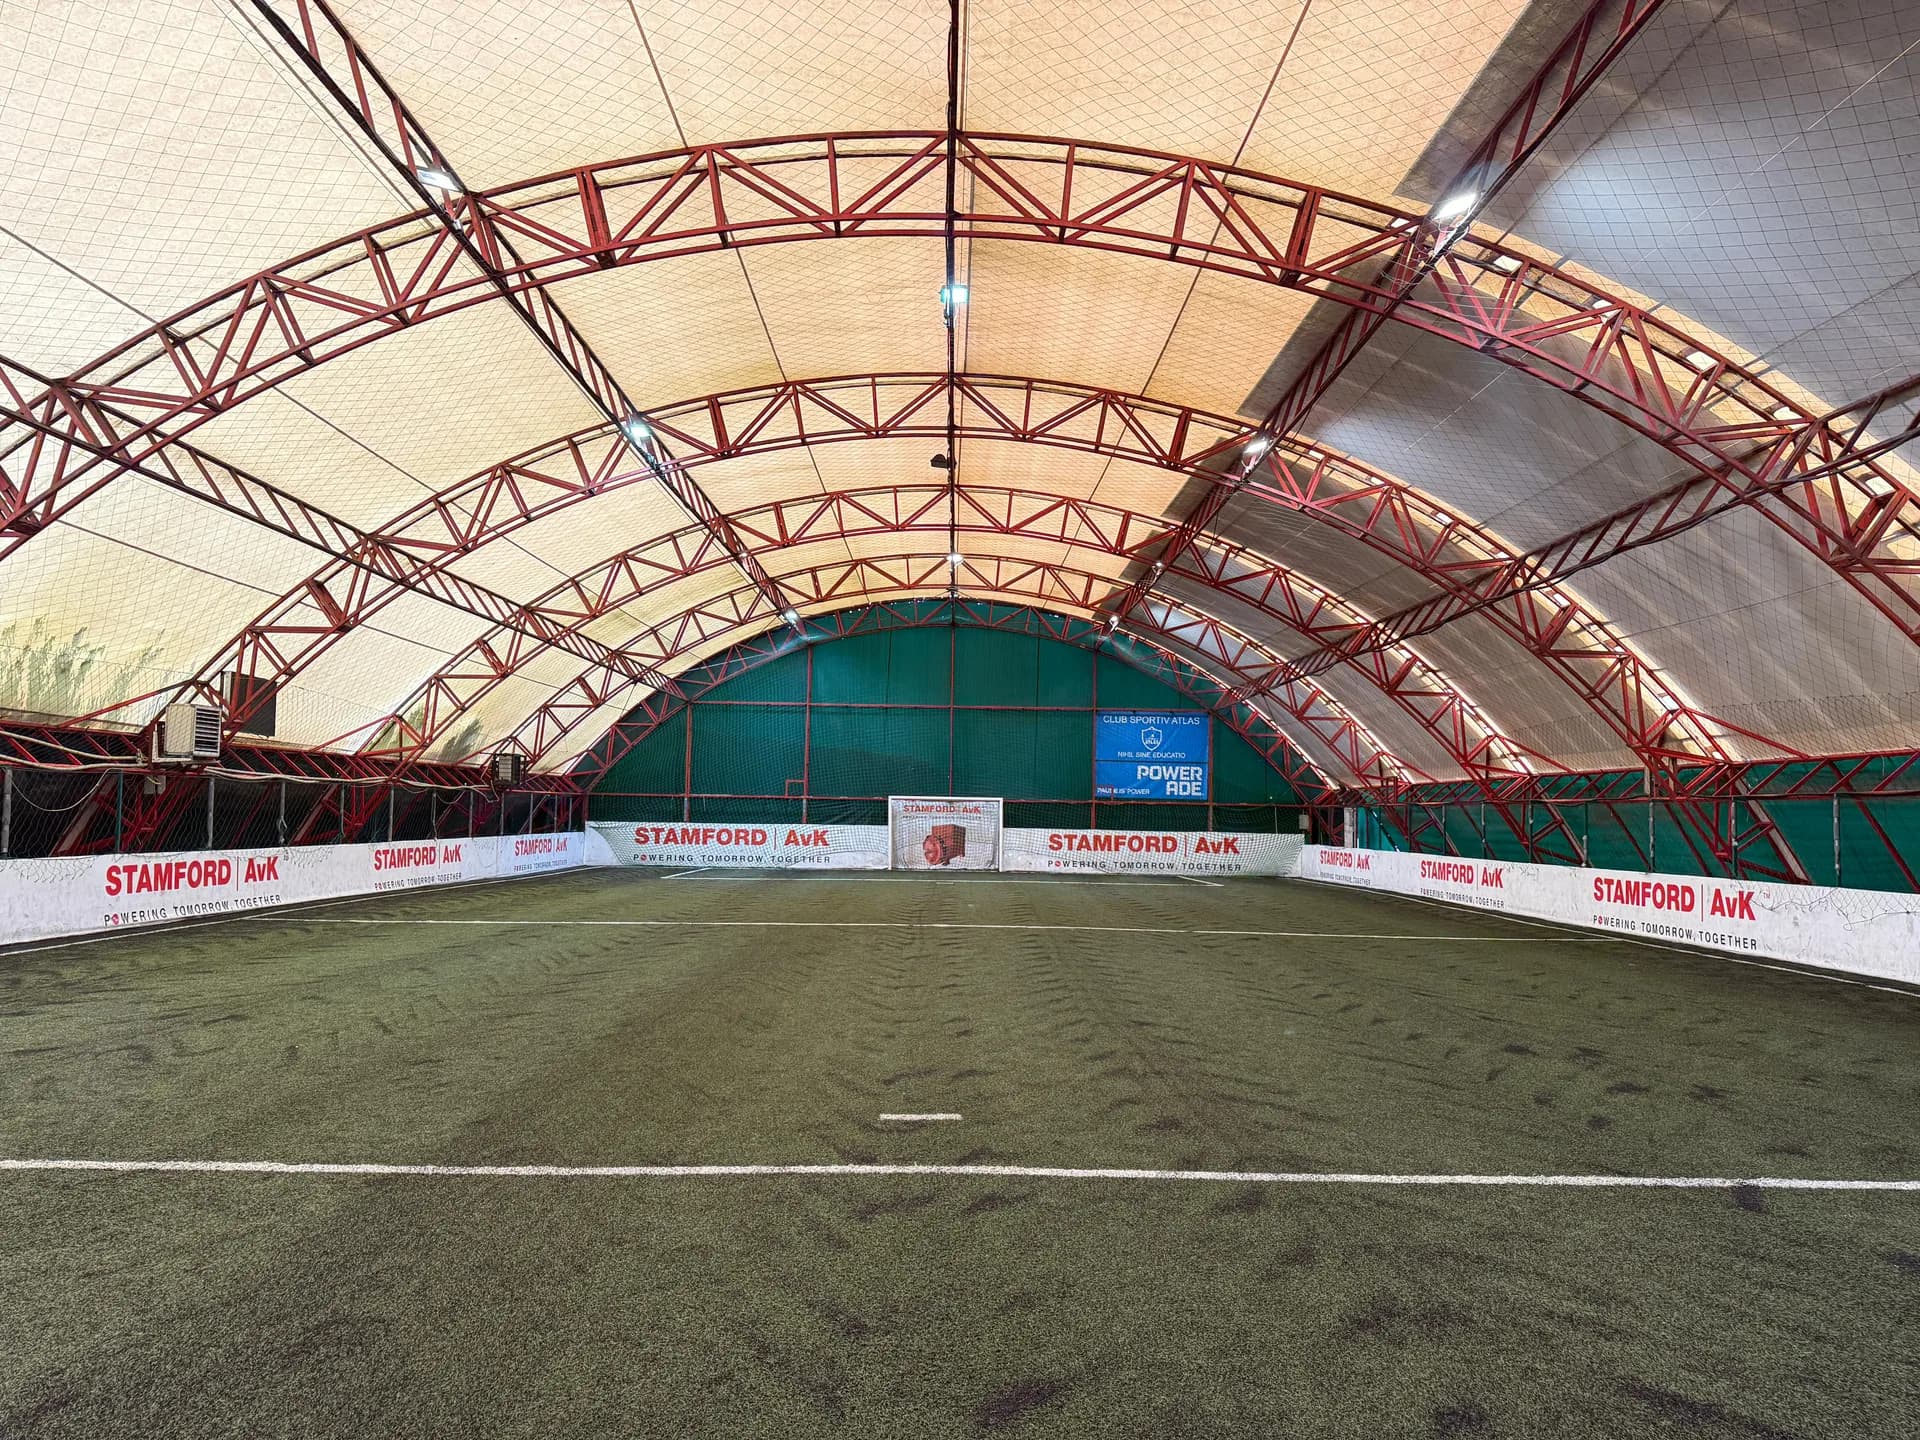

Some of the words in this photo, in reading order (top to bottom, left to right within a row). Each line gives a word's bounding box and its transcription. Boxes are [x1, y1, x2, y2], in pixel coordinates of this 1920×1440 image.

[1103, 715, 1127, 724] CLUB
[1129, 715, 1171, 724] SPORTIV
[1172, 716, 1200, 725] ATLAS
[1152, 751, 1186, 759] EDUCATIO
[1137, 765, 1203, 781] POWER
[1166, 781, 1204, 796] ADE
[903, 804, 956, 813] STAMFORD
[962, 805, 982, 814] AvK
[634, 827, 768, 846] STAMFORD
[784, 829, 830, 847] AvK
[1048, 833, 1178, 853] STAMFORD
[1195, 836, 1240, 855] AvK
[514, 838, 552, 857] STAMFORD
[374, 846, 436, 871] STAMFORD
[443, 844, 462, 864] AvK
[633, 854, 694, 862] POWERING
[771, 855, 831, 864] TOGETHER
[1048, 860, 1107, 869] POWERING
[1113, 861, 1179, 871] TOMORROW,
[1181, 862, 1242, 871] TOGETHER
[1320, 849, 1353, 868] STAMFORD
[105, 859, 231, 896] STAMFORD
[244, 856, 279, 883] AvK
[374, 879, 405, 891] POWERING
[437, 872, 462, 882] TOGETHER
[1420, 859, 1474, 885] STAMFORD
[1481, 866, 1504, 889] AvK
[1420, 887, 1444, 900] POWERING
[1475, 896, 1505, 909] TOGETHER
[1593, 876, 1695, 913] STAMFORD
[1710, 888, 1756, 921] AvK
[104, 907, 167, 926] POWERING
[234, 894, 282, 909] TOGETHER
[1593, 914, 1637, 931] POWERING
[1641, 922, 1696, 942] TOMORROW,
[1698, 930, 1758, 951] TOGETHER
